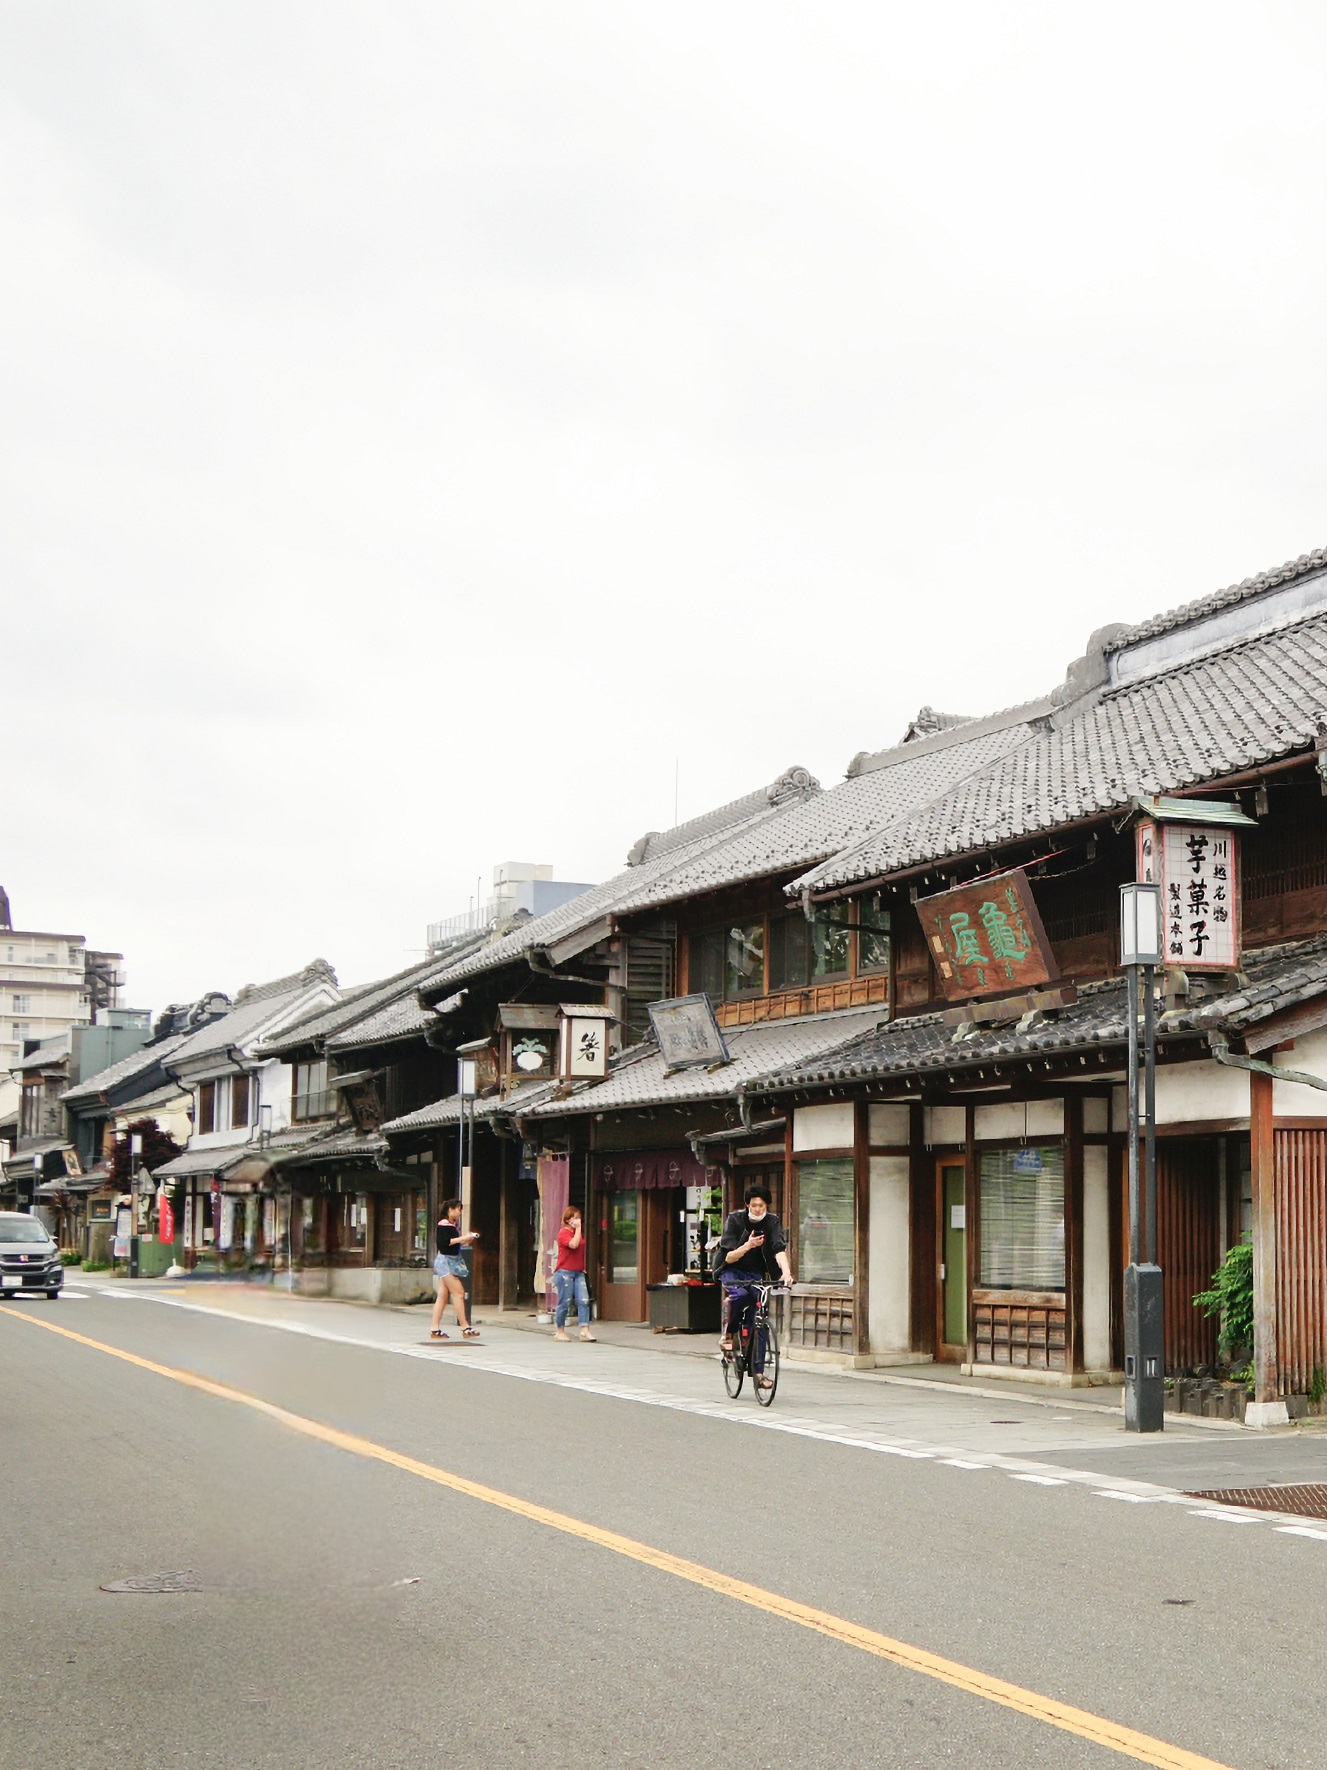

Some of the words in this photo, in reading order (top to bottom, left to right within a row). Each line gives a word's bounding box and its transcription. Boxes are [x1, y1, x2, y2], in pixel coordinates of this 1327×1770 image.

[1185, 834, 1210, 956] 芋菓子
[1213, 840, 1228, 923] 川越名物
